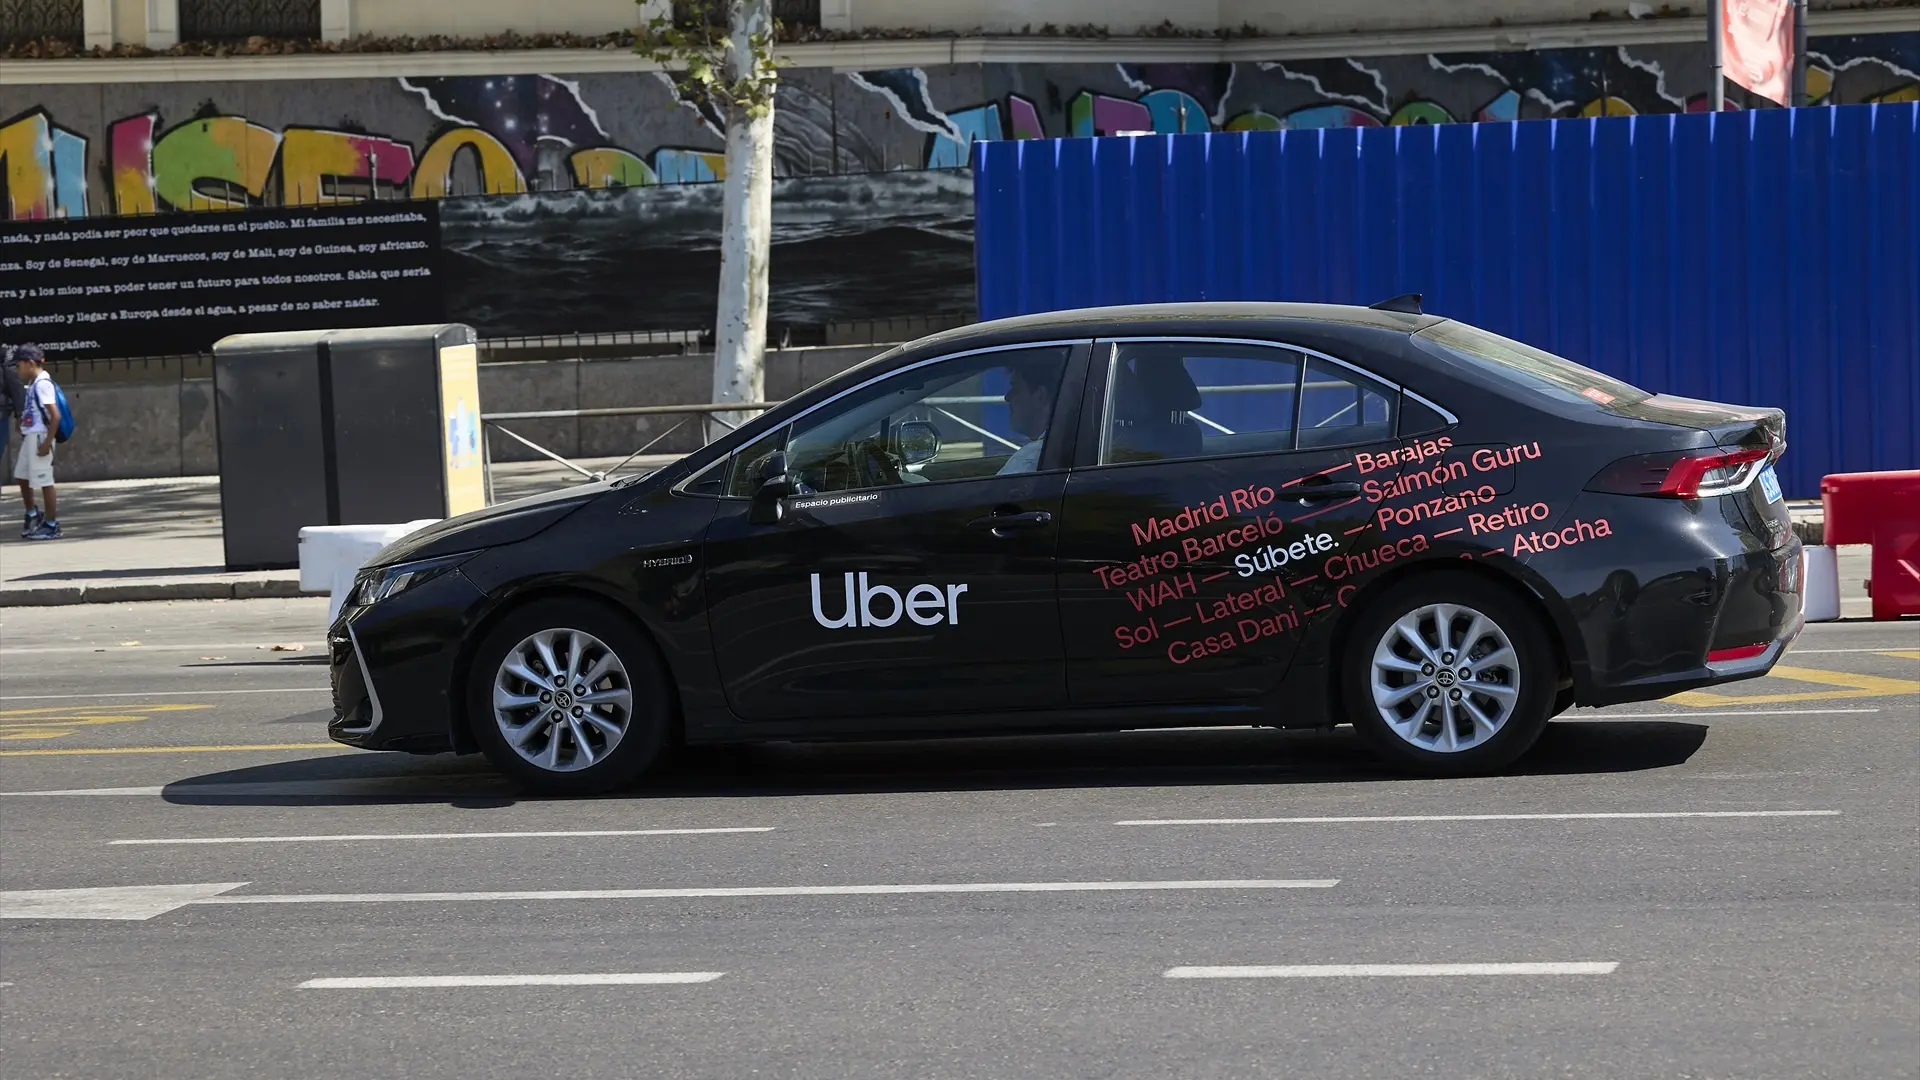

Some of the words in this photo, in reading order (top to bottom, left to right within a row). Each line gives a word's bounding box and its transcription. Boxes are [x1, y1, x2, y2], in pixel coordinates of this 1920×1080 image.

[3, 234, 32, 243] nada,
[35, 235, 41, 243] y
[44, 232, 70, 241] nada
[104, 230, 121, 238] ser
[124, 229, 148, 238] peor
[150, 228, 169, 237] que
[171, 224, 220, 236] quedarse
[238, 222, 247, 231] el
[250, 220, 288, 232] pueblo.
[291, 219, 305, 228] Mi
[307, 217, 345, 227] familia
[366, 213, 426, 224] necesitaba,
[26, 260, 45, 270] Soy
[48, 259, 61, 268] de
[64, 257, 108, 267] Senegal,
[111, 257, 129, 266] soy
[132, 255, 145, 263] de
[148, 253, 209, 263] Marruecos,
[212, 252, 230, 261] soy
[233, 250, 245, 258] de
[278, 248, 296, 257] soy
[299, 246, 312, 255] de
[315, 245, 356, 254] Guinea,
[359, 244, 377, 253] soy
[380, 241, 428, 250] africano.
[3, 317, 22, 326] que
[25, 314, 65, 324] hacerlo
[67, 315, 74, 324] y
[77, 312, 108, 322] llegar
[120, 310, 159, 319] Europa
[161, 307, 192, 316] desde
[195, 306, 204, 315] el
[207, 306, 236, 316] agua,
[248, 304, 278, 314] pesar
[281, 302, 293, 311] de
[313, 300, 342, 309] saber
[345, 298, 379, 307] nadar.
[19, 290, 26, 299] y
[39, 287, 54, 296] los
[86, 286, 111, 295] para
[114, 283, 145, 294] poder
[148, 282, 177, 290] tener
[198, 279, 231, 287] futuro
[235, 278, 260, 287] para
[262, 275, 291, 284] todos
[295, 273, 344, 282] nosotros.
[380, 270, 400, 280] que
[795, 499, 829, 509] Espacio
[829, 493, 878, 506] publicitario
[1093, 551, 1179, 590] Teatro
[1181, 511, 1284, 563] Barceló
[1363, 460, 1468, 503] Salmón
[1472, 442, 1542, 472] Guru
[1131, 495, 1229, 546] Madrid
[1230, 485, 1275, 513] Río
[1355, 436, 1452, 475] Barajas
[1114, 617, 1159, 649] Sol
[1196, 575, 1285, 624] Lateral
[1325, 533, 1429, 580] Chueca
[1468, 502, 1549, 536] Retiro
[1126, 572, 1197, 612] WAH
[1234, 532, 1340, 577] Súbete.
[1376, 485, 1496, 532] Ponzano
[811, 571, 967, 629] Uber
[1168, 632, 1237, 664] Casa
[1237, 605, 1299, 643] Dani
[1513, 518, 1612, 557] Atocha
